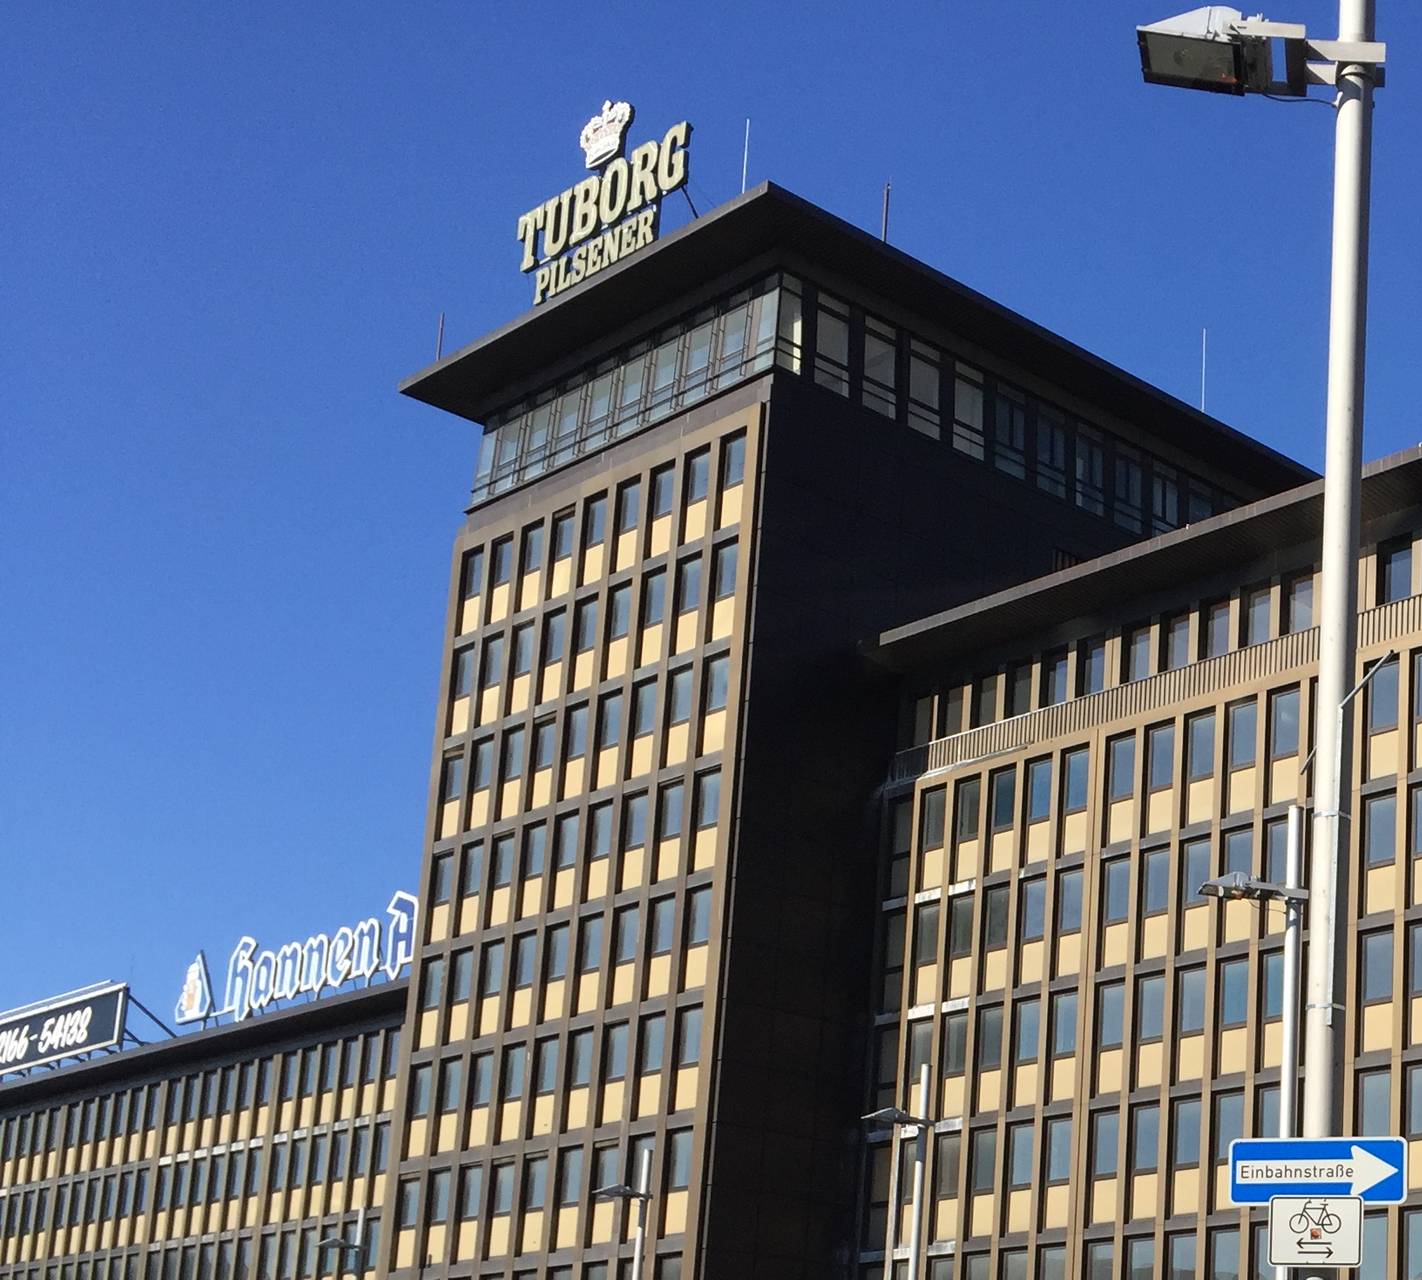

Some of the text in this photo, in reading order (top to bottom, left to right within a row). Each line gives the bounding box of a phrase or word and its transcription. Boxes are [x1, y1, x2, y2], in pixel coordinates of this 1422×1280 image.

[517, 121, 693, 272] TUBORG
[533, 210, 655, 305] PILSENER
[1240, 1164, 1354, 1180] Einbahnstraße
